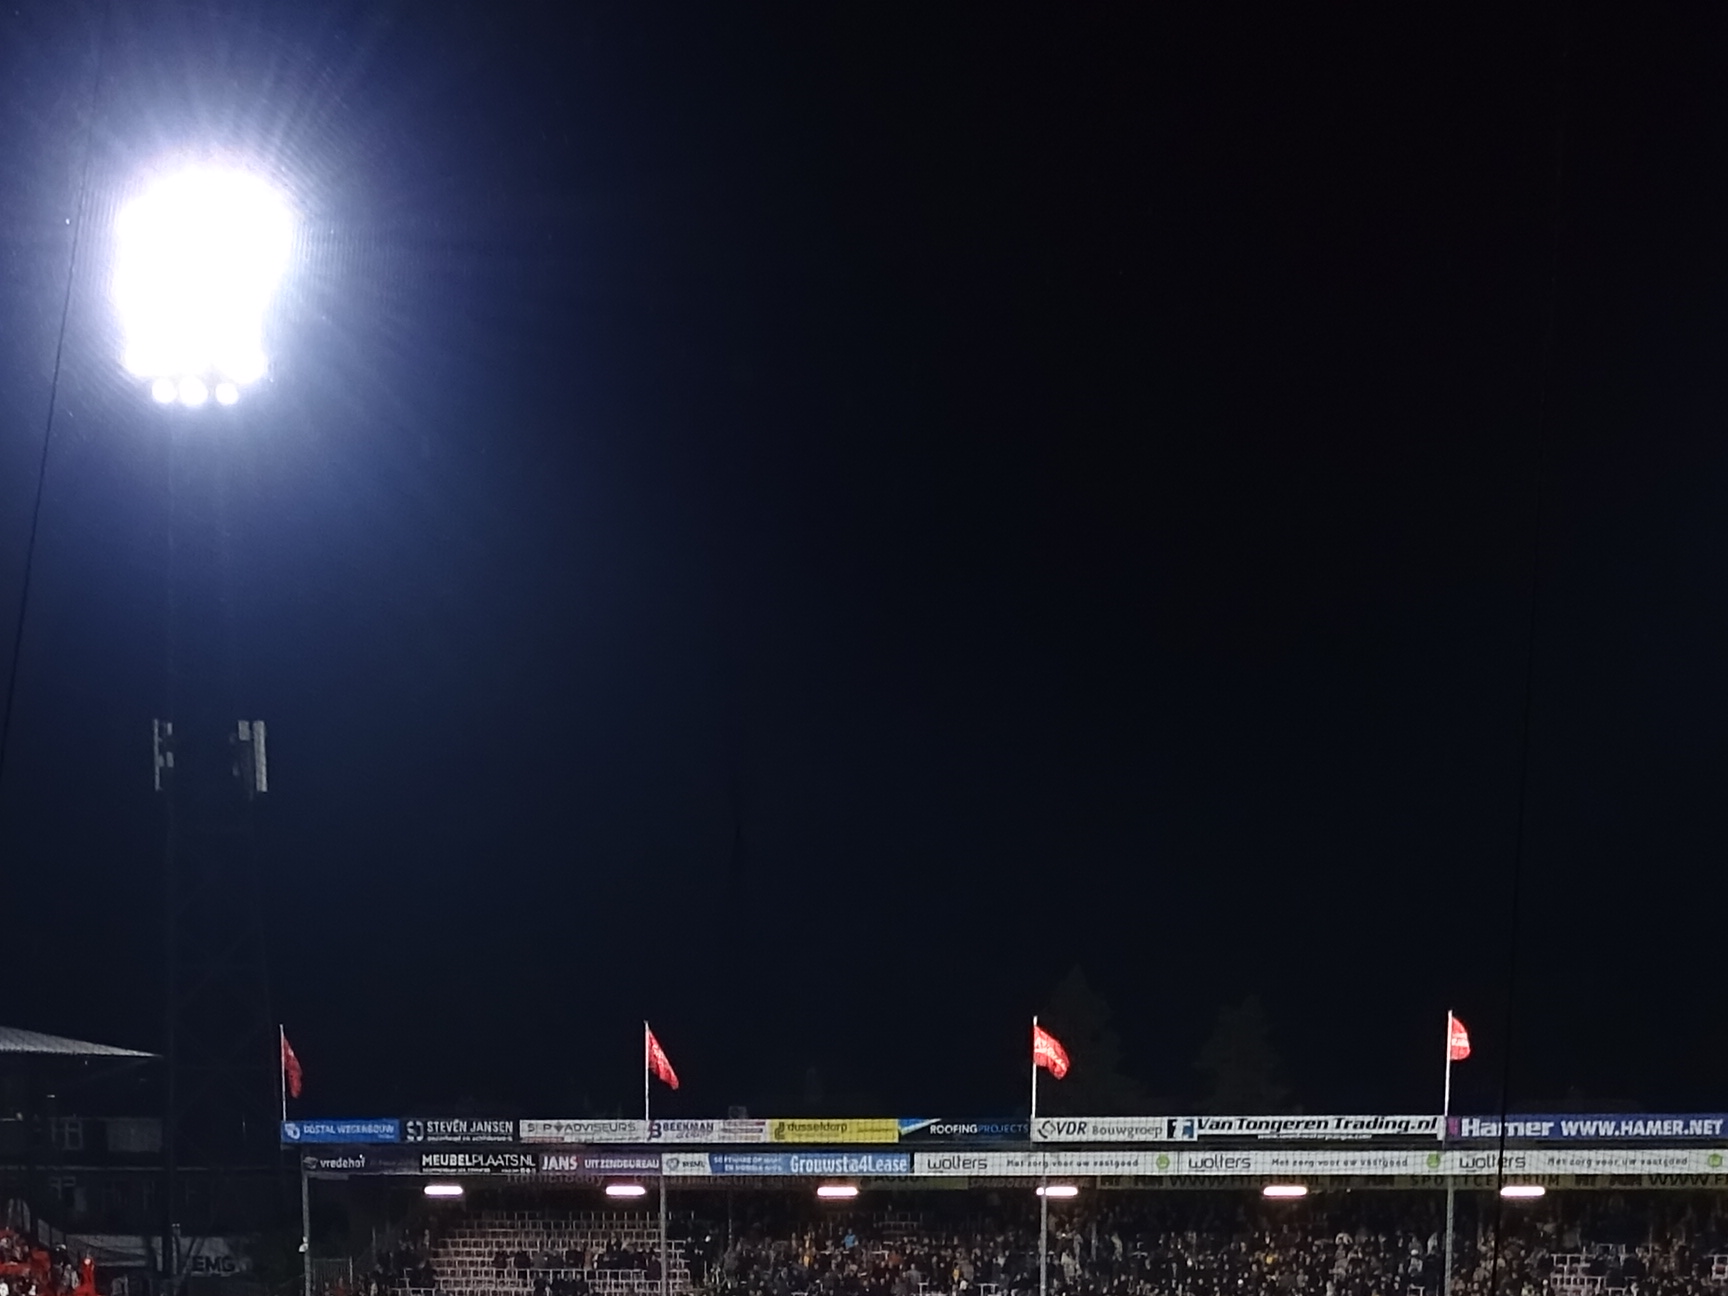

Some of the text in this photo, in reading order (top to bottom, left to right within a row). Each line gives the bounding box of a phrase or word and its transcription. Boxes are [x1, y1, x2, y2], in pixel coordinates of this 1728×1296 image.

[426, 1120, 514, 1133] STEVEN JANSEN
[1056, 1120, 1163, 1139] VDR Bouwgroep
[1235, 1117, 1329, 1134] Tongeren
[1334, 1116, 1438, 1134] Trading.nl
[1461, 1117, 1724, 1138] Hamer WWW.HAMER.NET
[541, 1155, 578, 1171] JANS
[927, 1155, 988, 1170] wolters
[1188, 1154, 1252, 1169] wolters
